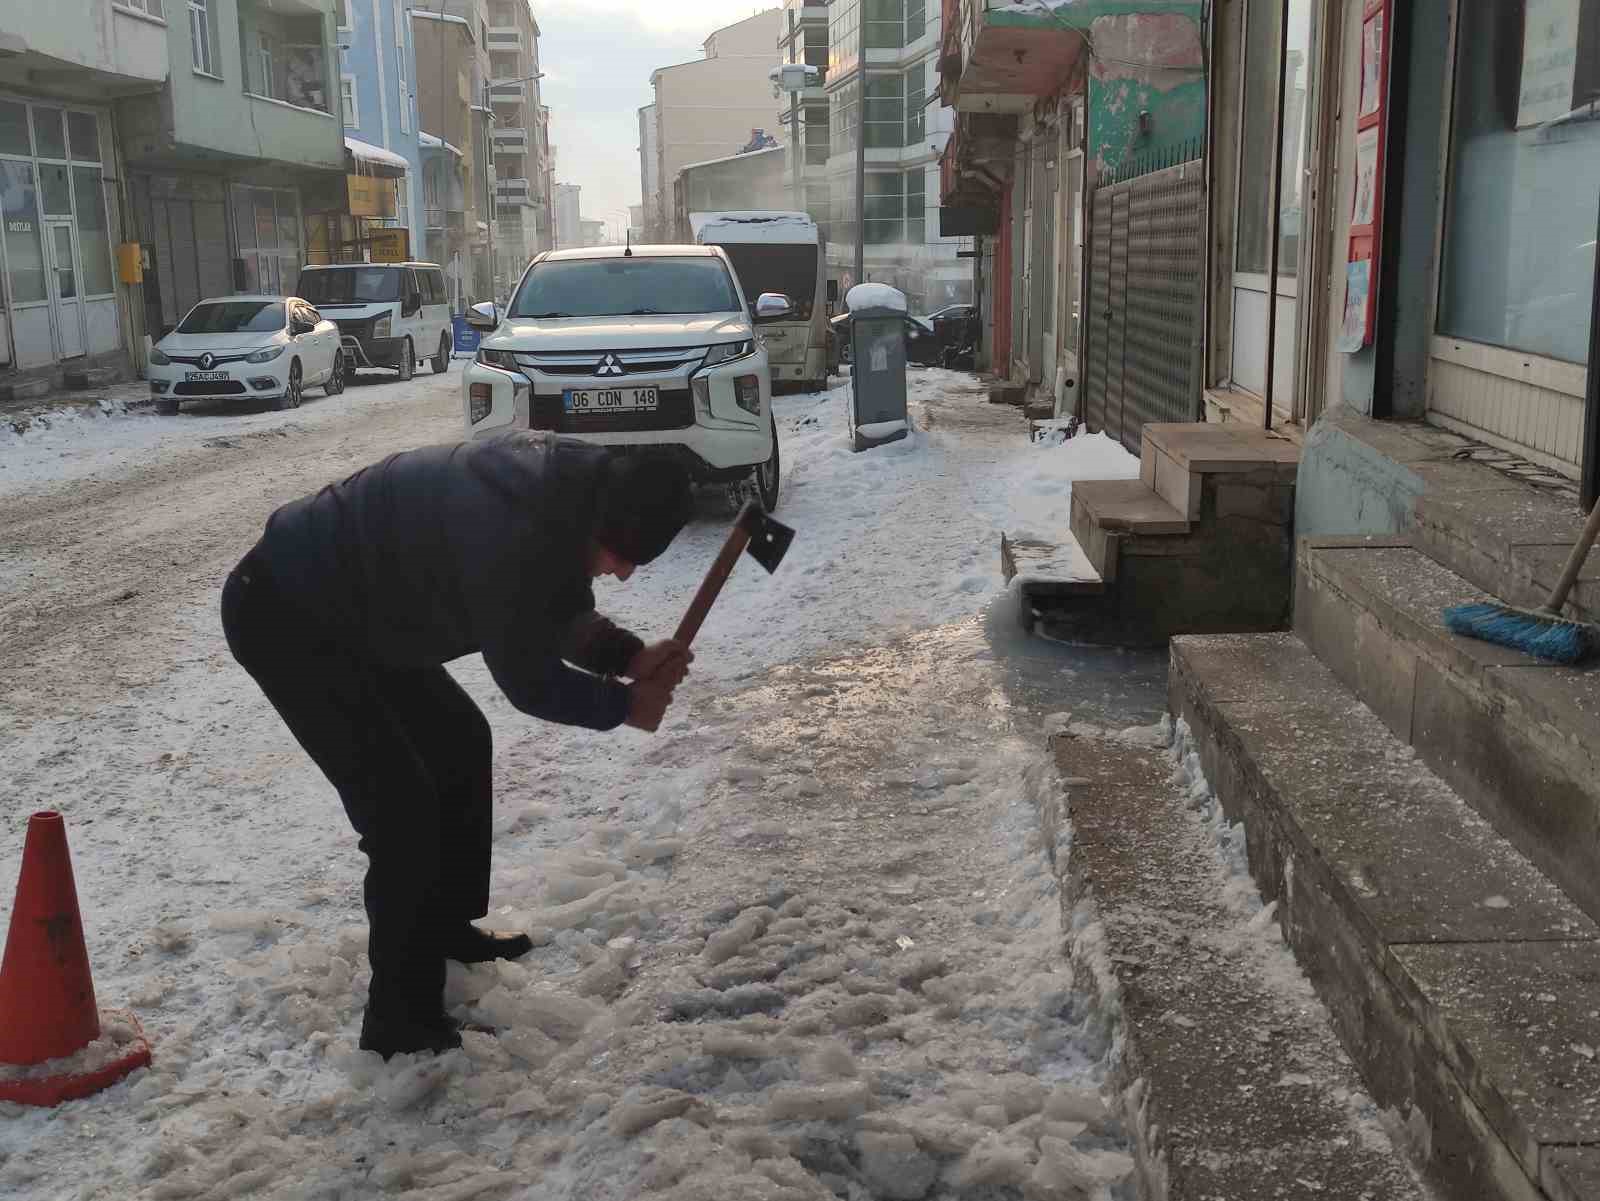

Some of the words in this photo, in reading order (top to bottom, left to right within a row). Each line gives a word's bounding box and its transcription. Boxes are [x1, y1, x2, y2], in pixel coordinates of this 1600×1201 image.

[573, 392, 589, 407] 06
[598, 391, 622, 406] CDN
[633, 390, 655, 405] 148
